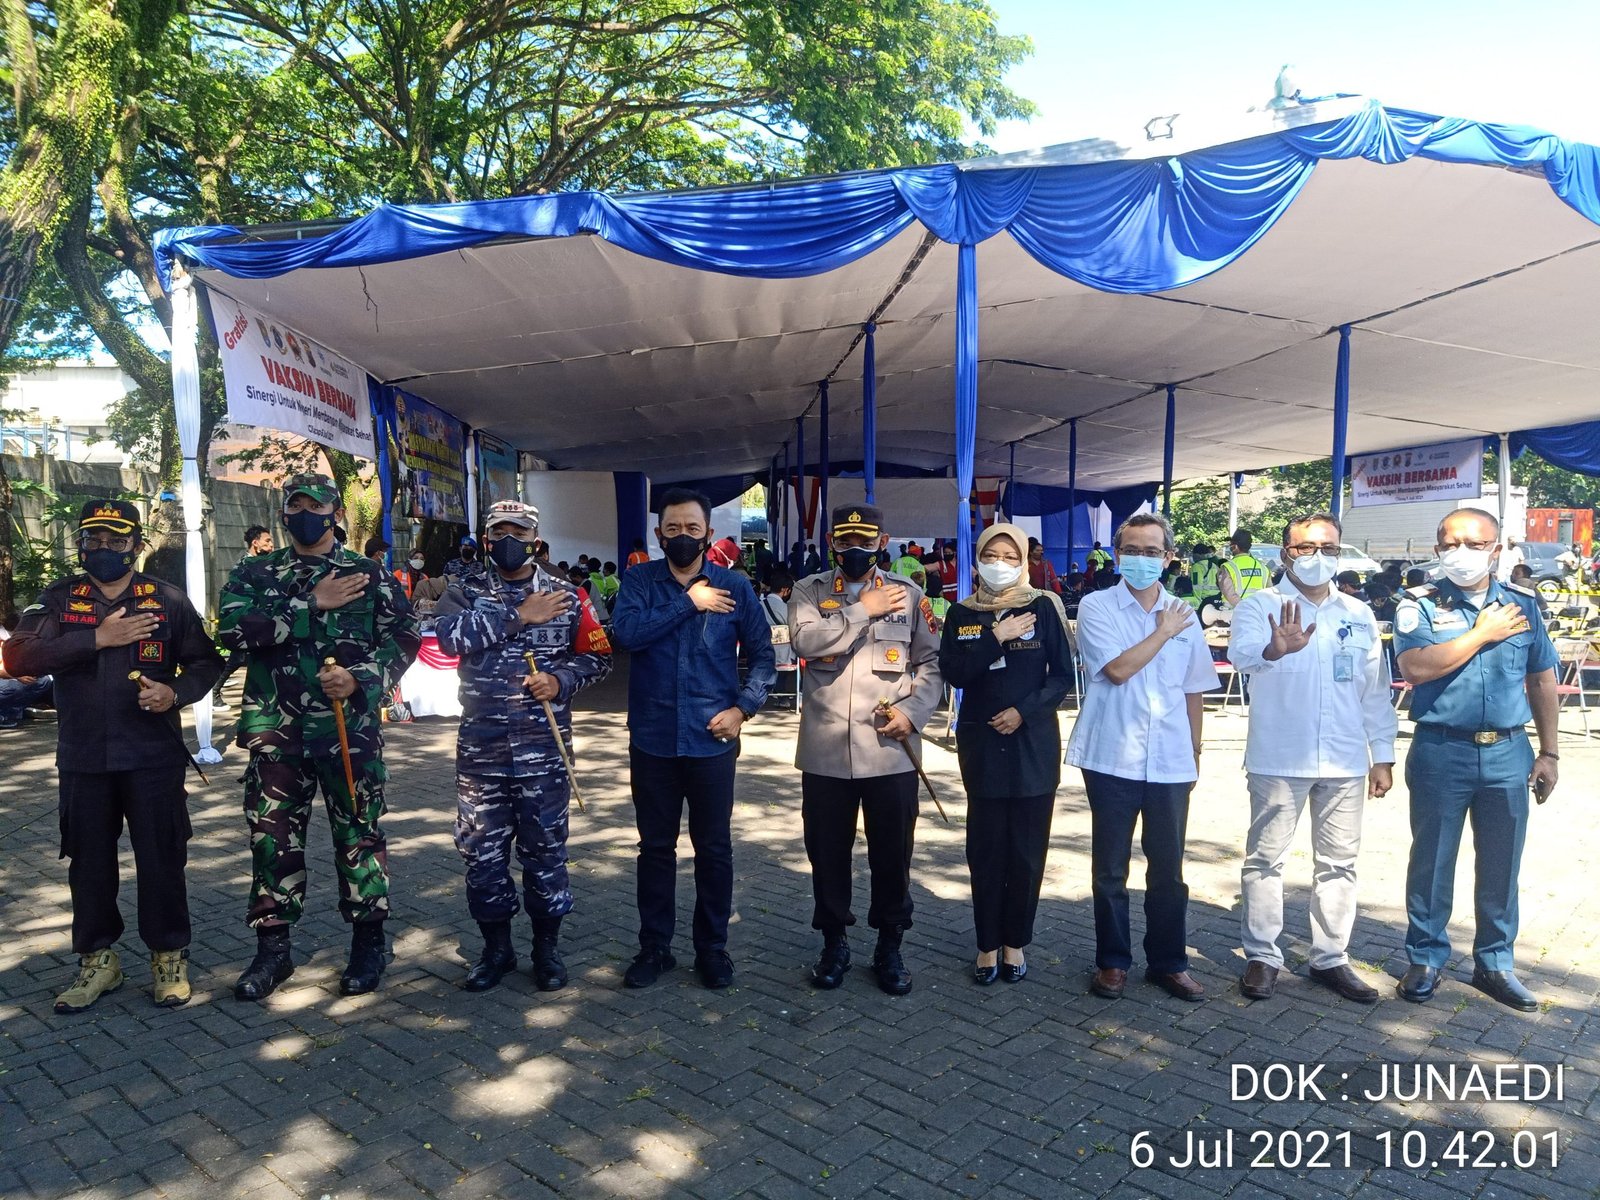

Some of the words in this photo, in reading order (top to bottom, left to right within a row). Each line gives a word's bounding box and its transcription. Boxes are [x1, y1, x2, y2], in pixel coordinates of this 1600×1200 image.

[246, 385, 276, 406] Sinergi
[277, 392, 297, 410] Untuk
[261, 355, 316, 399] VAKSIN
[316, 378, 356, 420] BERSAMA
[1367, 472, 1401, 488] VAKSIN
[1405, 466, 1457, 484] BERSAMA
[1456, 481, 1472, 489] Sehat
[81, 616, 97, 624] ARI
